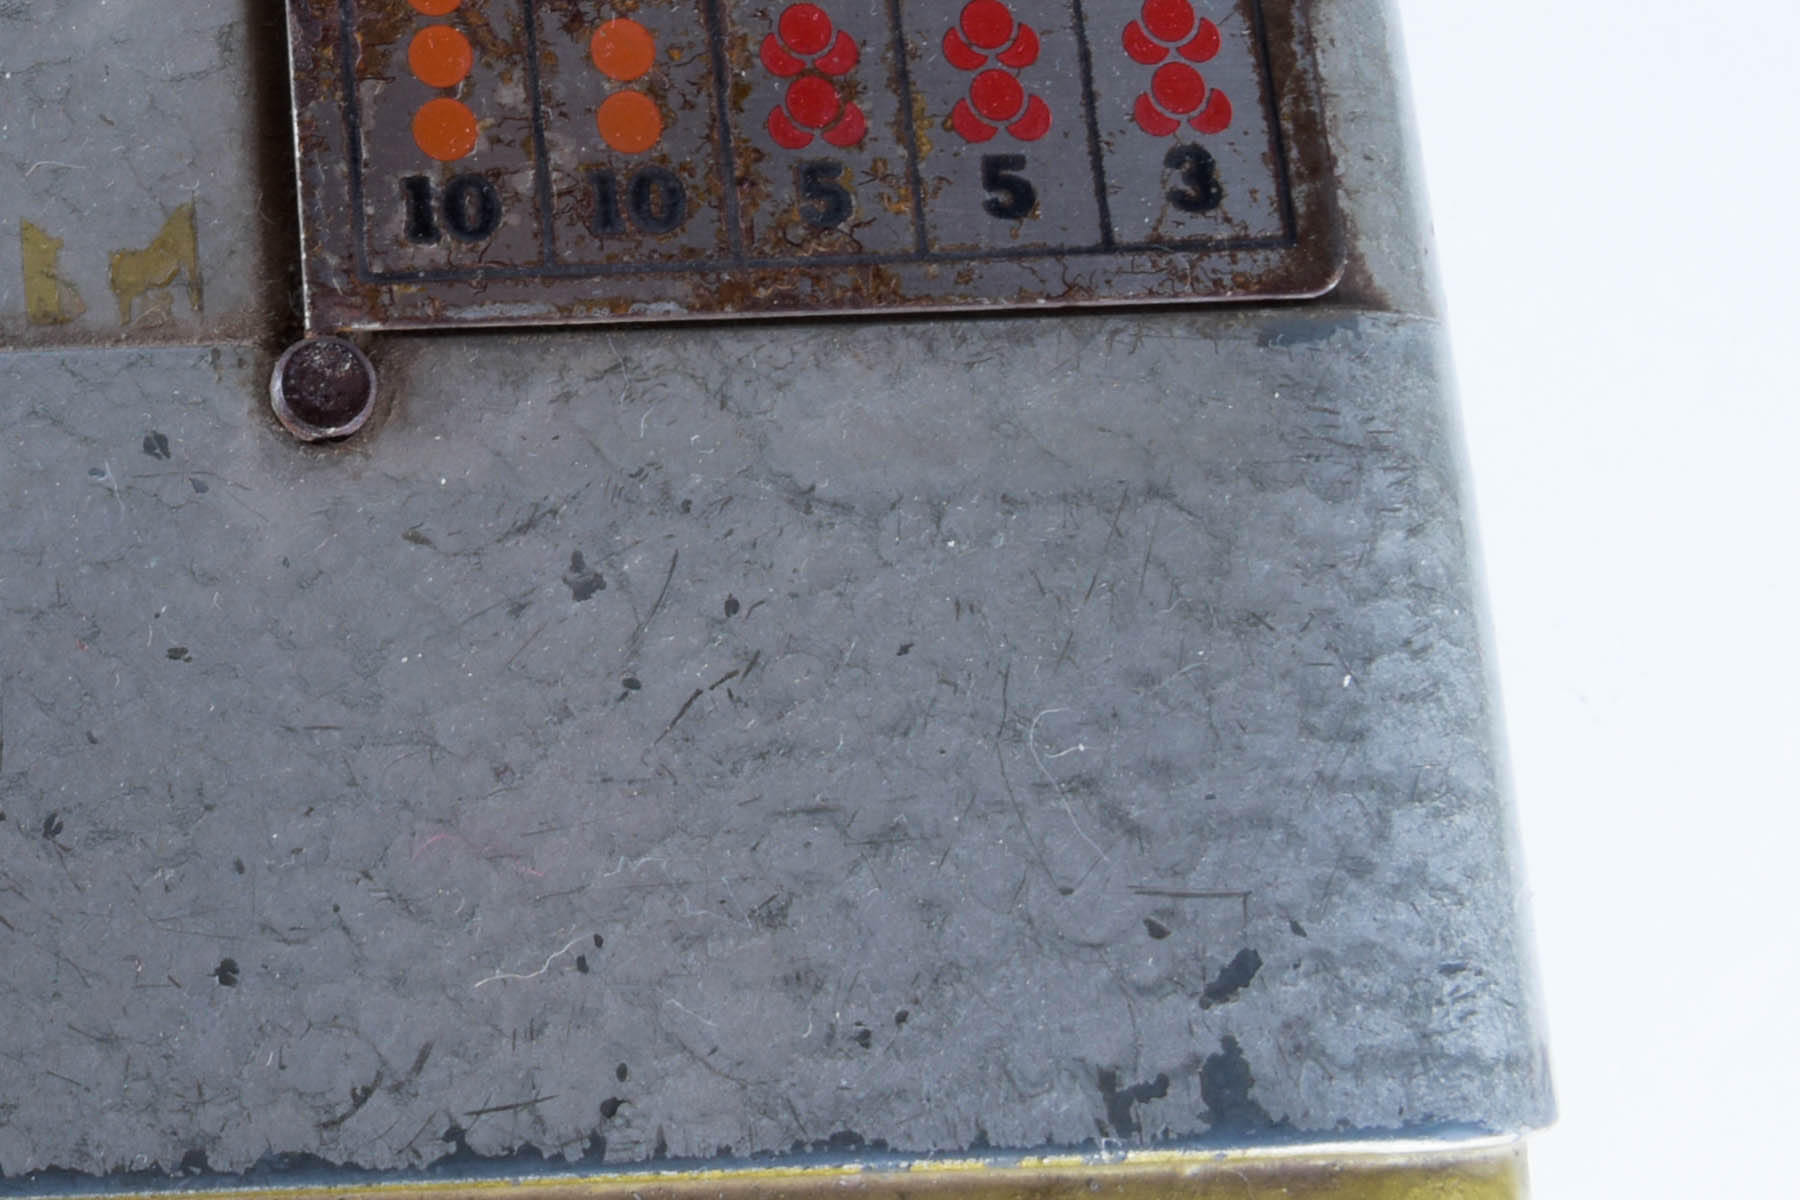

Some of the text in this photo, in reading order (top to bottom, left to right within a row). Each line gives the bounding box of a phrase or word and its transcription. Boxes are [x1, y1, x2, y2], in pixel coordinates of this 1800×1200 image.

[403, 172, 502, 245] 10
[588, 165, 687, 236] 10
[801, 159, 854, 230] 5
[981, 153, 1038, 221] 5
[1163, 142, 1224, 215] 3
